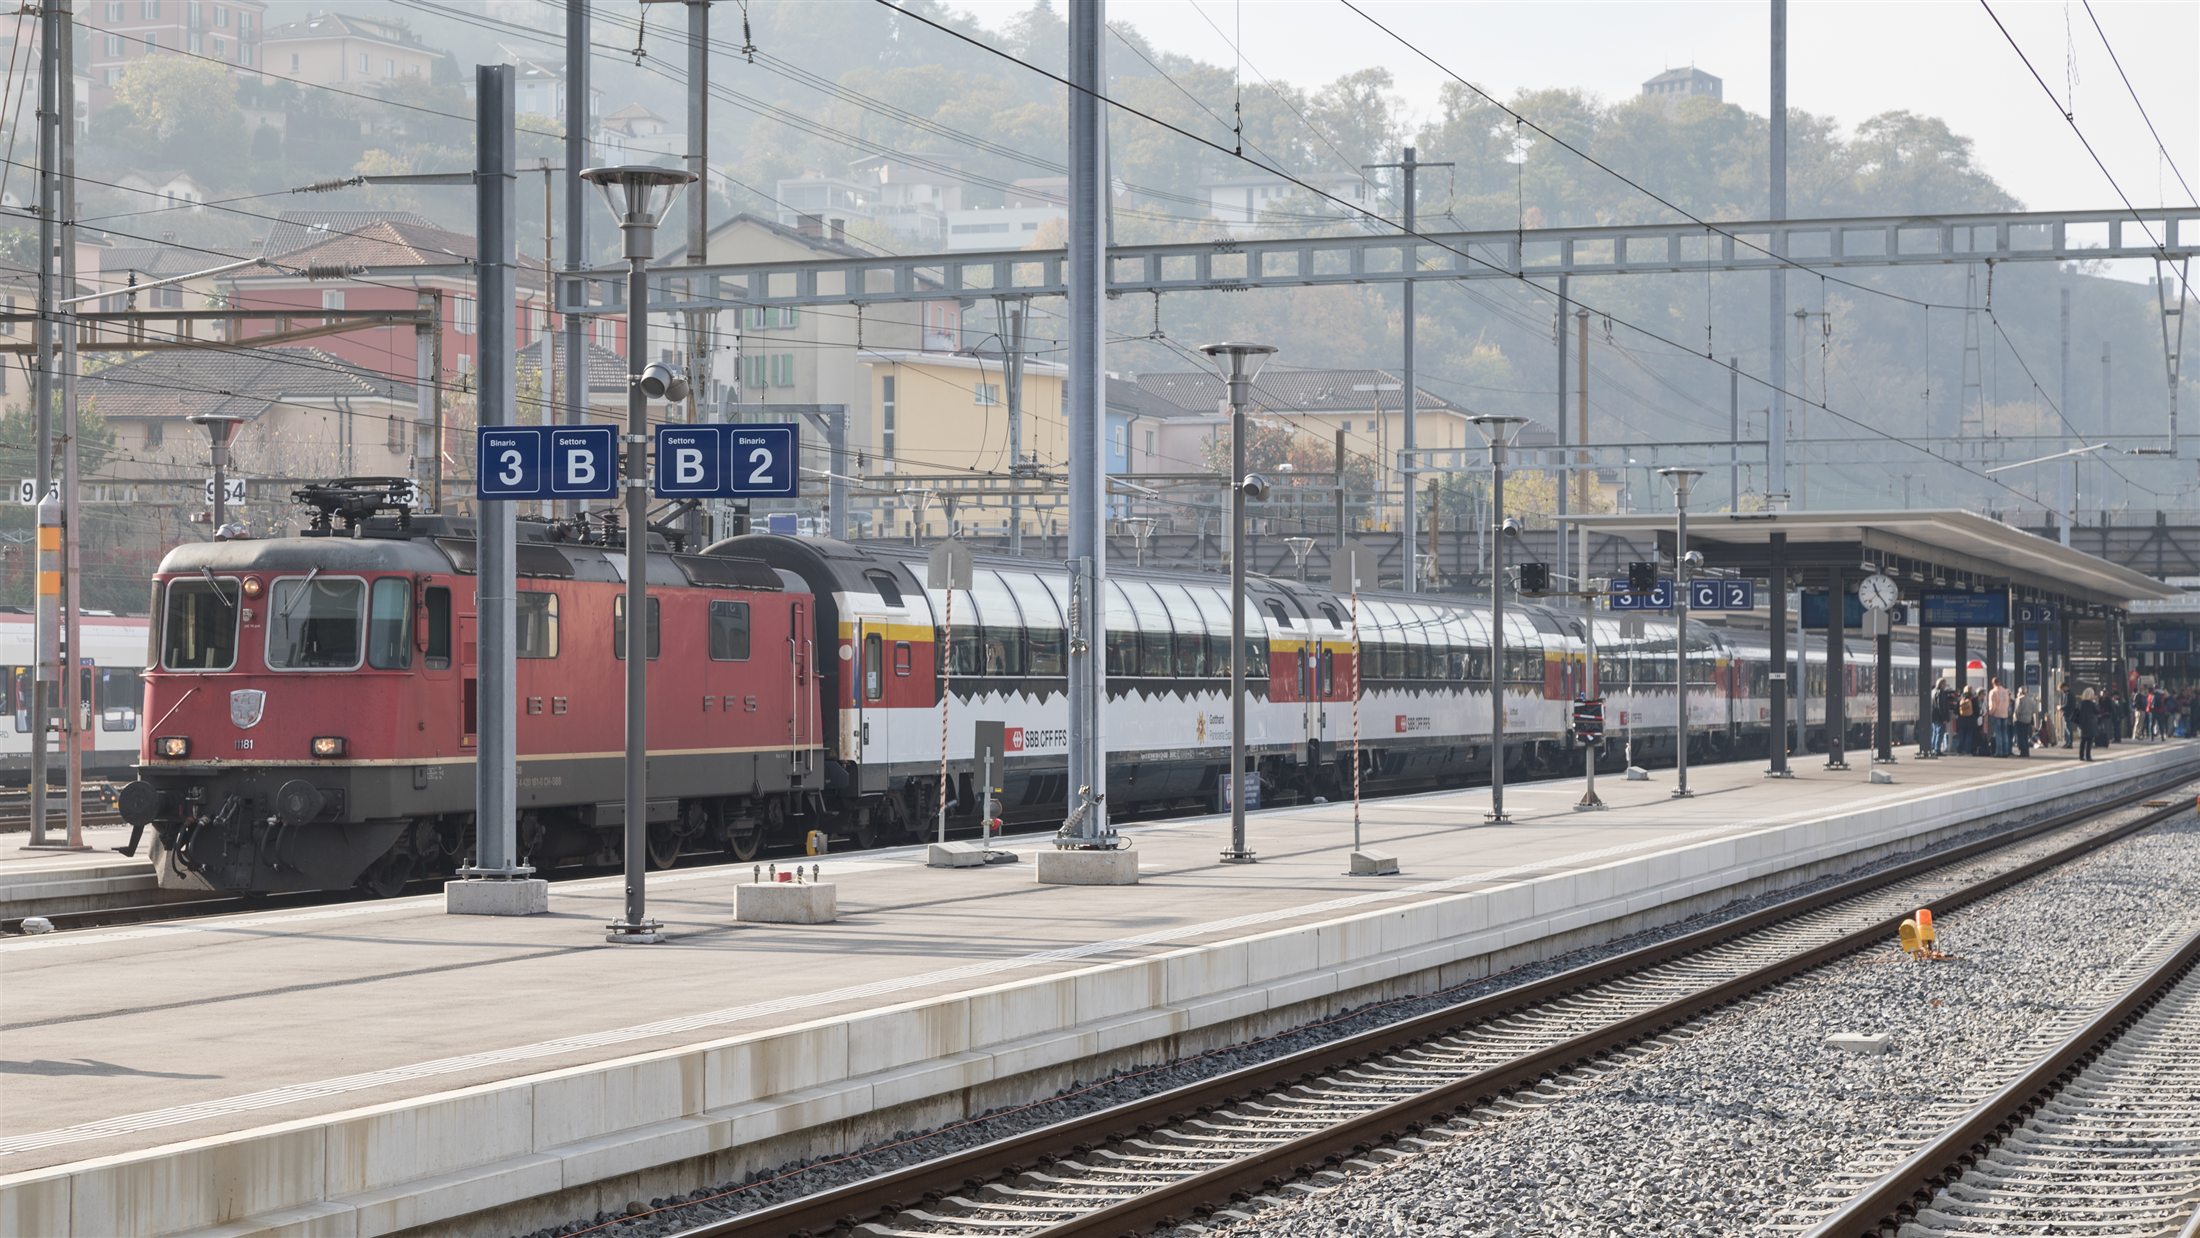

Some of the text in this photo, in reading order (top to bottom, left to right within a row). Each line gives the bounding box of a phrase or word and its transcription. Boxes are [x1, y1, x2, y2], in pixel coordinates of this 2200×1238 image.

[490, 439, 516, 447] Binario
[559, 438, 587, 446] Settore
[667, 437, 695, 445] Settore
[739, 437, 766, 445] Binario
[499, 450, 523, 486] 3
[568, 449, 596, 485] B
[676, 448, 704, 484] B
[749, 448, 773, 484] 2
[1620, 589, 1632, 605] 3
[1651, 588, 1664, 605] C
[1700, 588, 1713, 605] C
[1732, 589, 1743, 605] 2
[1892, 611, 1901, 621] D
[2022, 610, 2031, 621] D
[2043, 610, 2051, 621] 2
[1025, 729, 1068, 748] SBB CFF FFS
